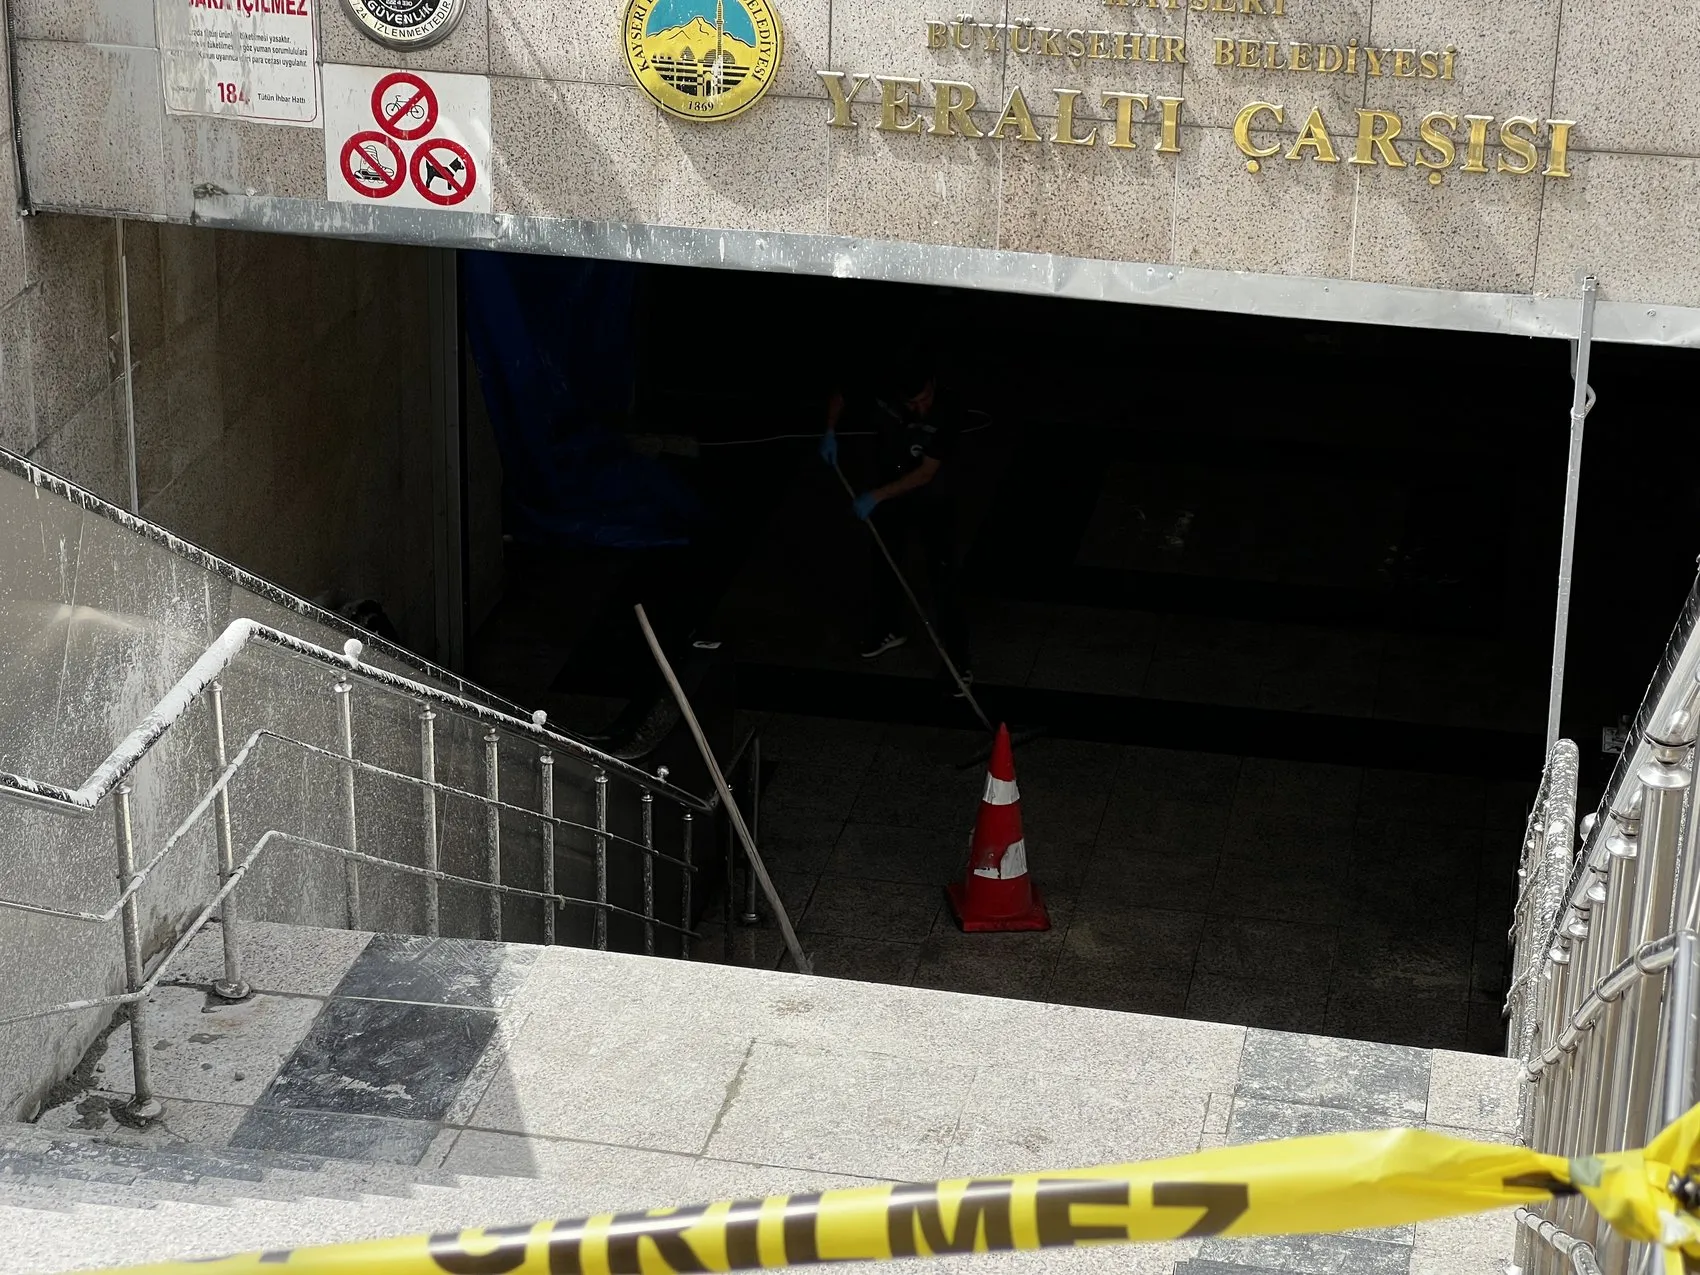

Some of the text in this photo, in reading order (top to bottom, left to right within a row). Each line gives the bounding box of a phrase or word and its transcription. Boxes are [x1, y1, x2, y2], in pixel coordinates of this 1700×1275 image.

[243, 44, 252, 53] göz
[253, 46, 271, 54] yuman
[631, 0, 775, 82] KAYSERİ ELEDİYESİ
[1212, 37, 1457, 80] BELEDİYESİ
[258, 93, 275, 101] Tütün
[688, 100, 714, 111] 1869
[816, 71, 1577, 185] YERALTI ÇARŞISI
